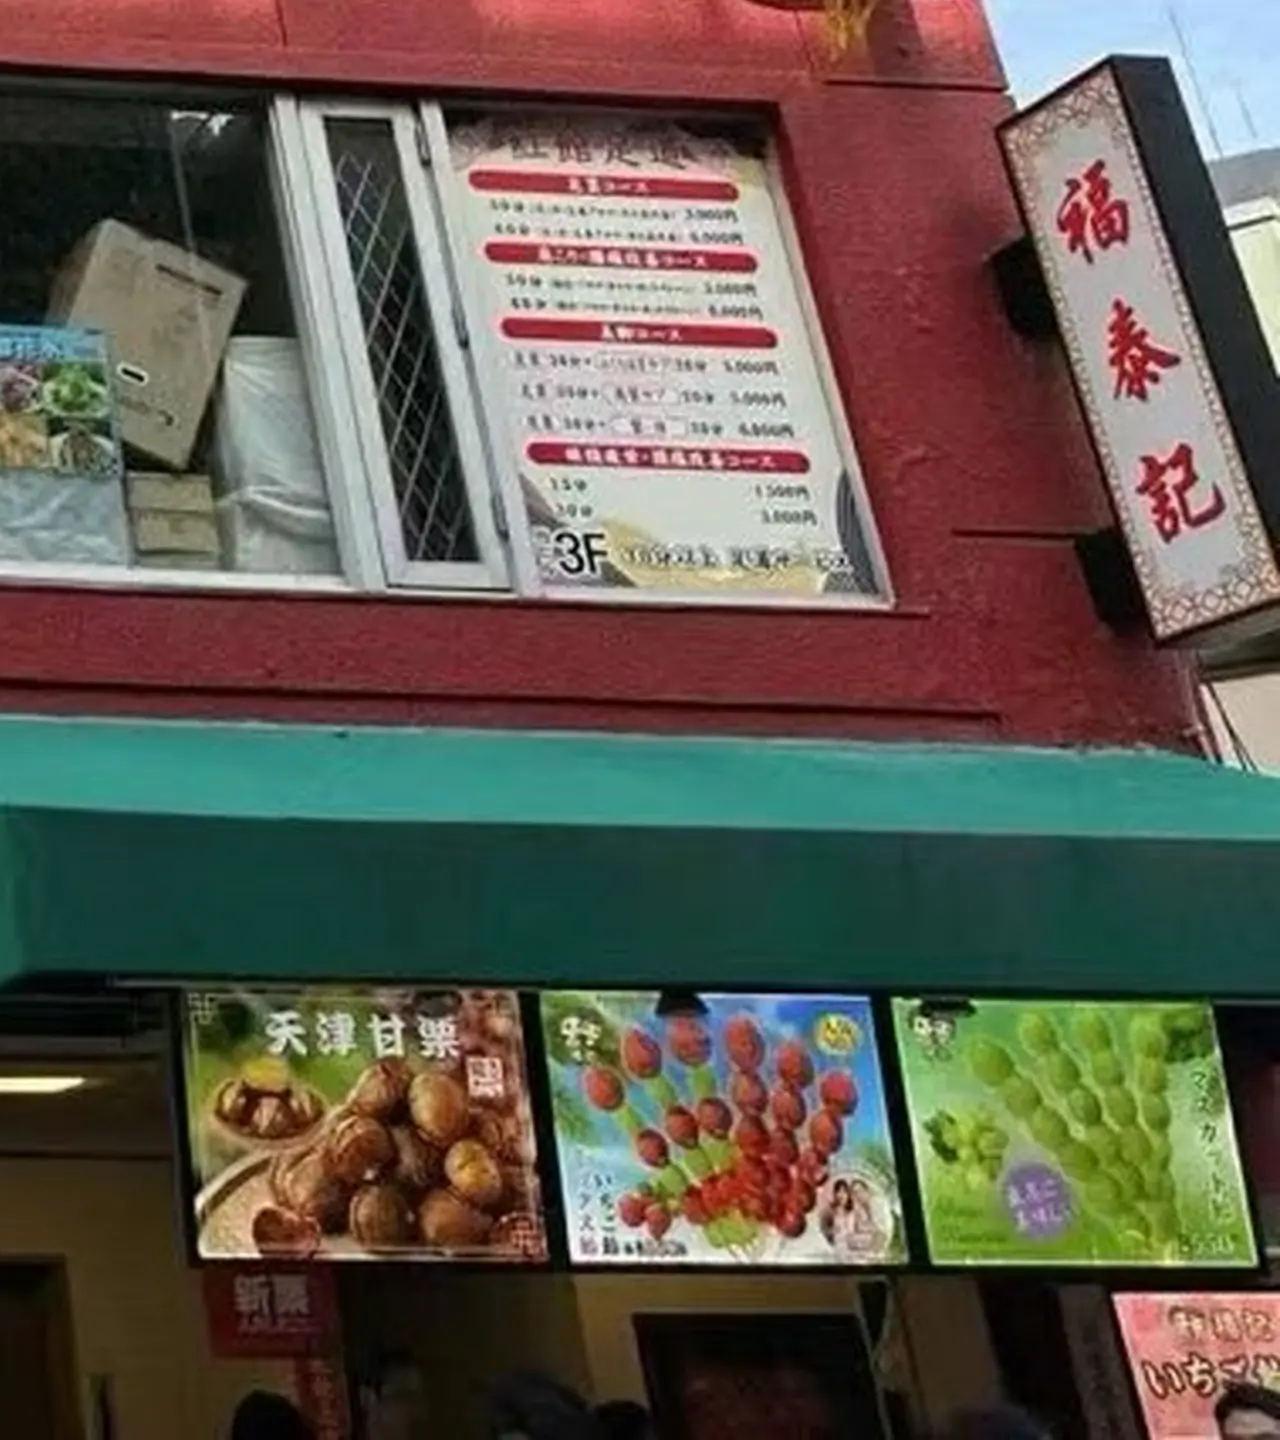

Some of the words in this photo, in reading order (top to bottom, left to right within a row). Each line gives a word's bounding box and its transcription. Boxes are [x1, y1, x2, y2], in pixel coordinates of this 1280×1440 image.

[1055, 159, 1227, 545] 福泰記
[555, 531, 608, 576] 3F
[263, 1009, 461, 1058] 天津甘栗
